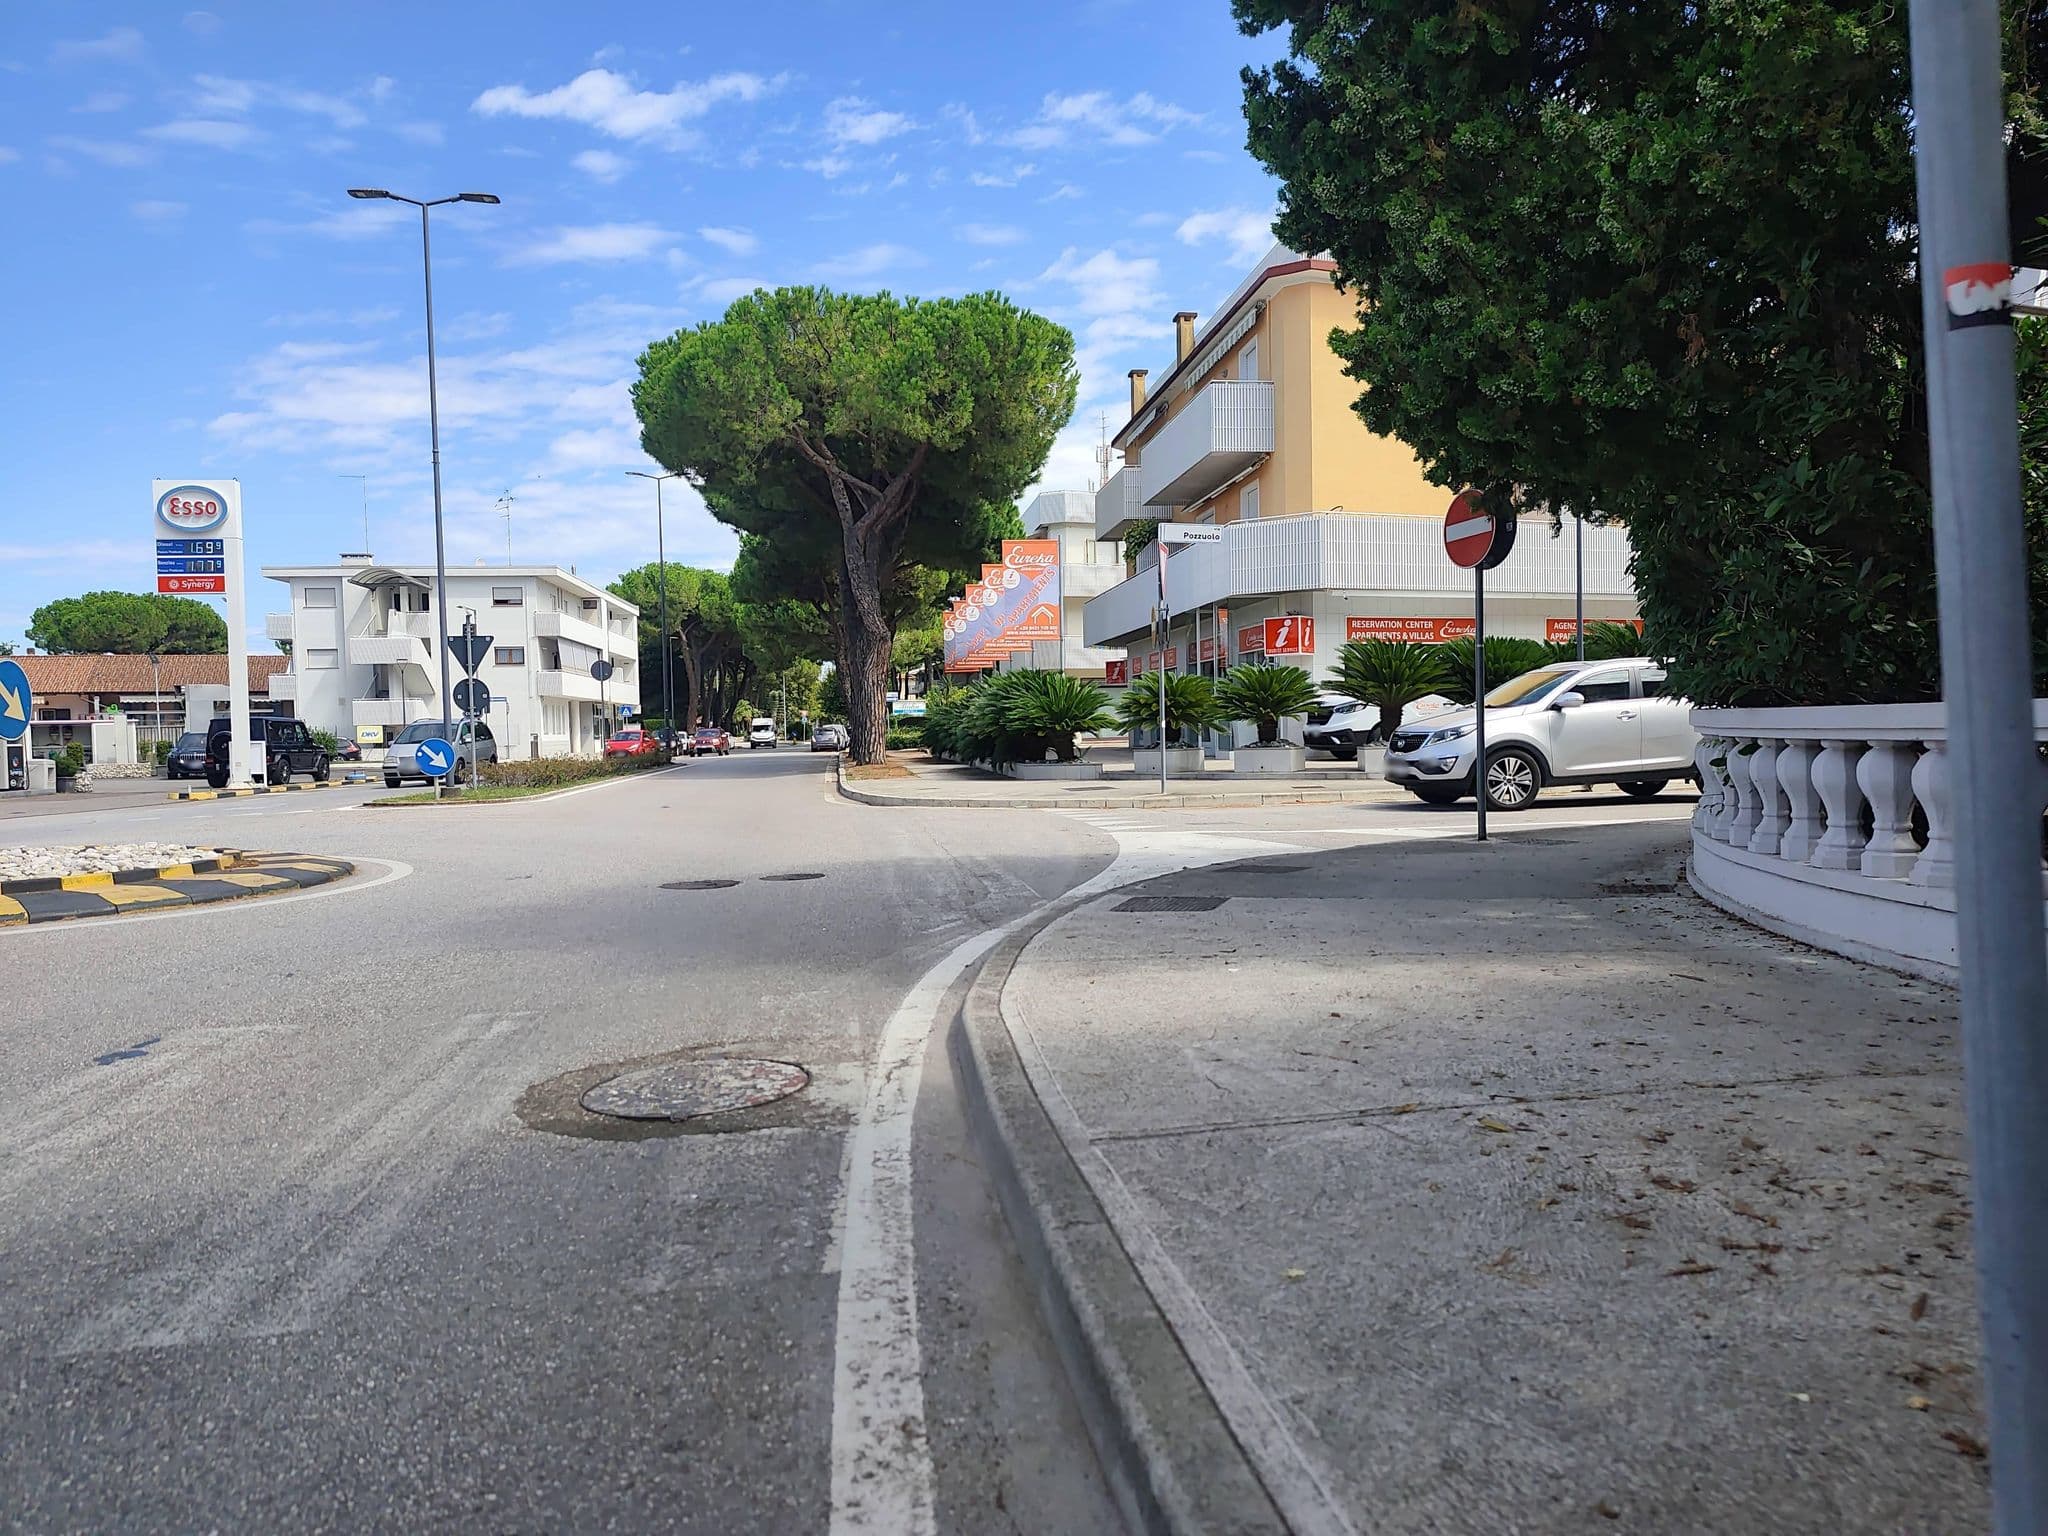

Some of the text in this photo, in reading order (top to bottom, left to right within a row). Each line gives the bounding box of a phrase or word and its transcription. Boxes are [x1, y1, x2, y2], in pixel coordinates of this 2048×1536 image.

[169, 497, 217, 516] Esso
[1183, 531, 1220, 540] Pozzuolo
[1005, 546, 1055, 568] Eureka
[181, 580, 215, 590] Synergy
[1351, 620, 1434, 629] RESERVATION CENTER
[1351, 631, 1434, 640] APARTMENTS & VILLAS
